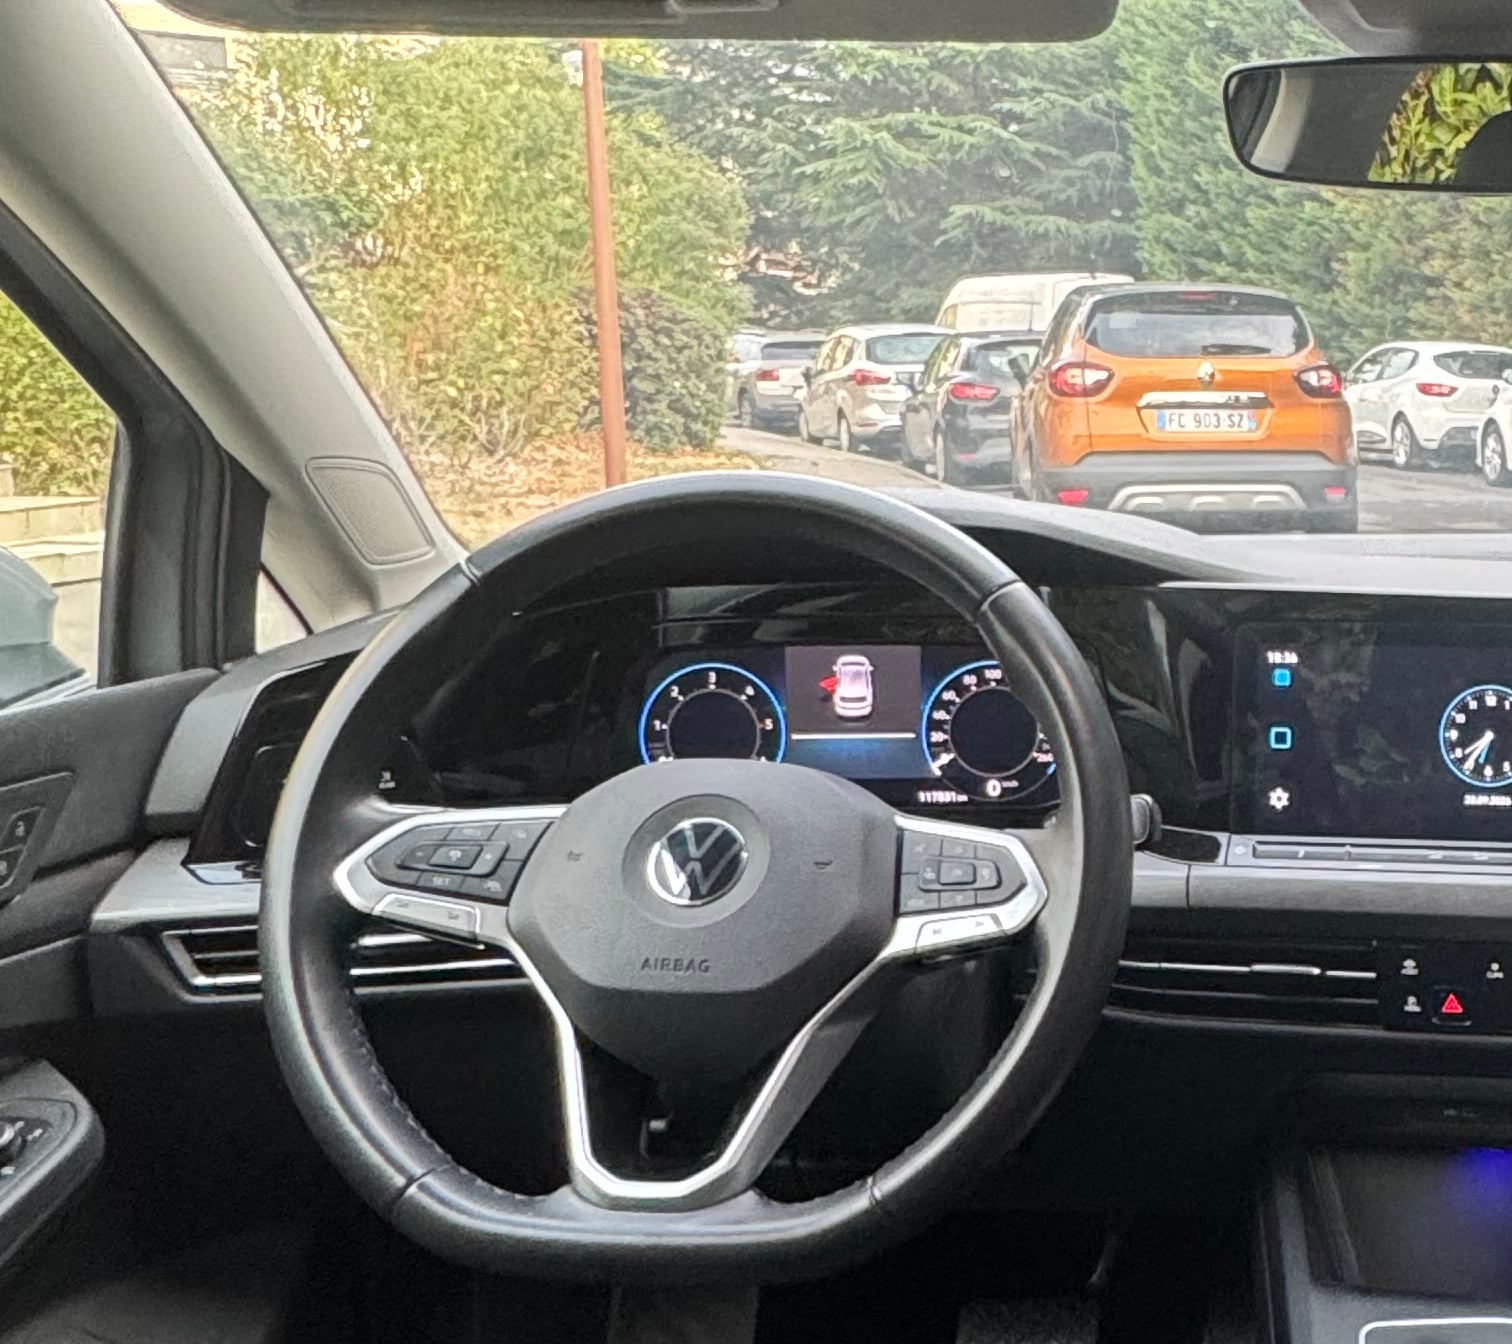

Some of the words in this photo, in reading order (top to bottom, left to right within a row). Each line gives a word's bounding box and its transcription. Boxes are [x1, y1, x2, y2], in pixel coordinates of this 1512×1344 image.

[1168, 412, 1186, 429] FC
[1193, 412, 1222, 429] 903
[1227, 412, 1245, 429] SZ
[670, 685, 680, 697] 2
[653, 720, 661, 731] 1
[764, 718, 774, 730] 5
[986, 779, 1001, 797] 0
[640, 957, 711, 974] AIRBAG
